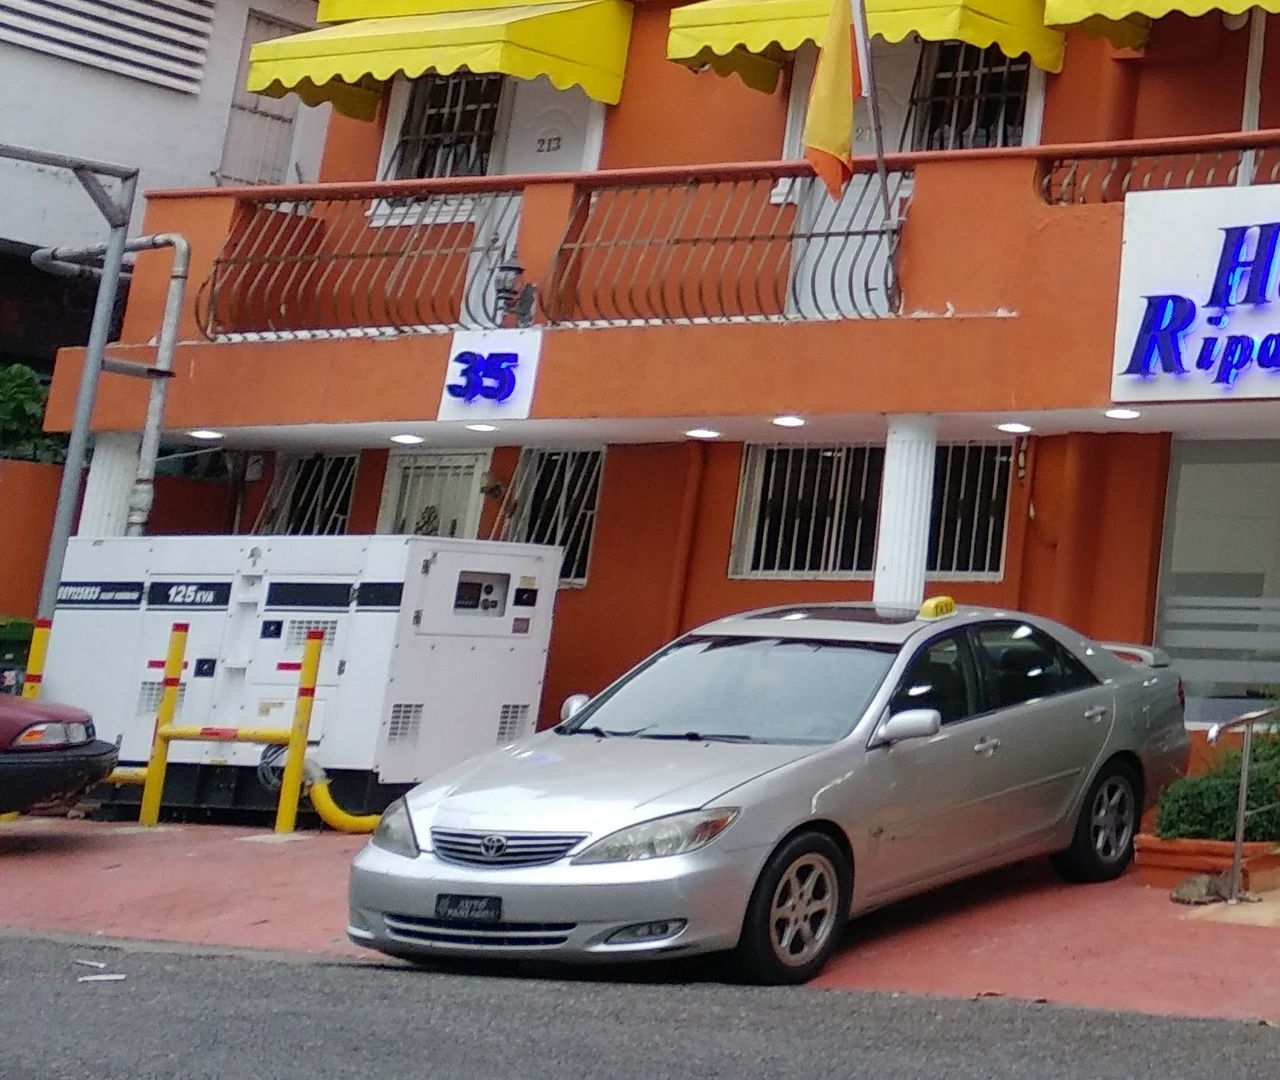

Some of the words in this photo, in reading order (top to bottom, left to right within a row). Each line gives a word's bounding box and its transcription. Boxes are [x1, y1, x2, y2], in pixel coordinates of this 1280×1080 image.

[536, 137, 562, 153] 213
[446, 351, 518, 402] 35
[168, 585, 198, 602] 125
